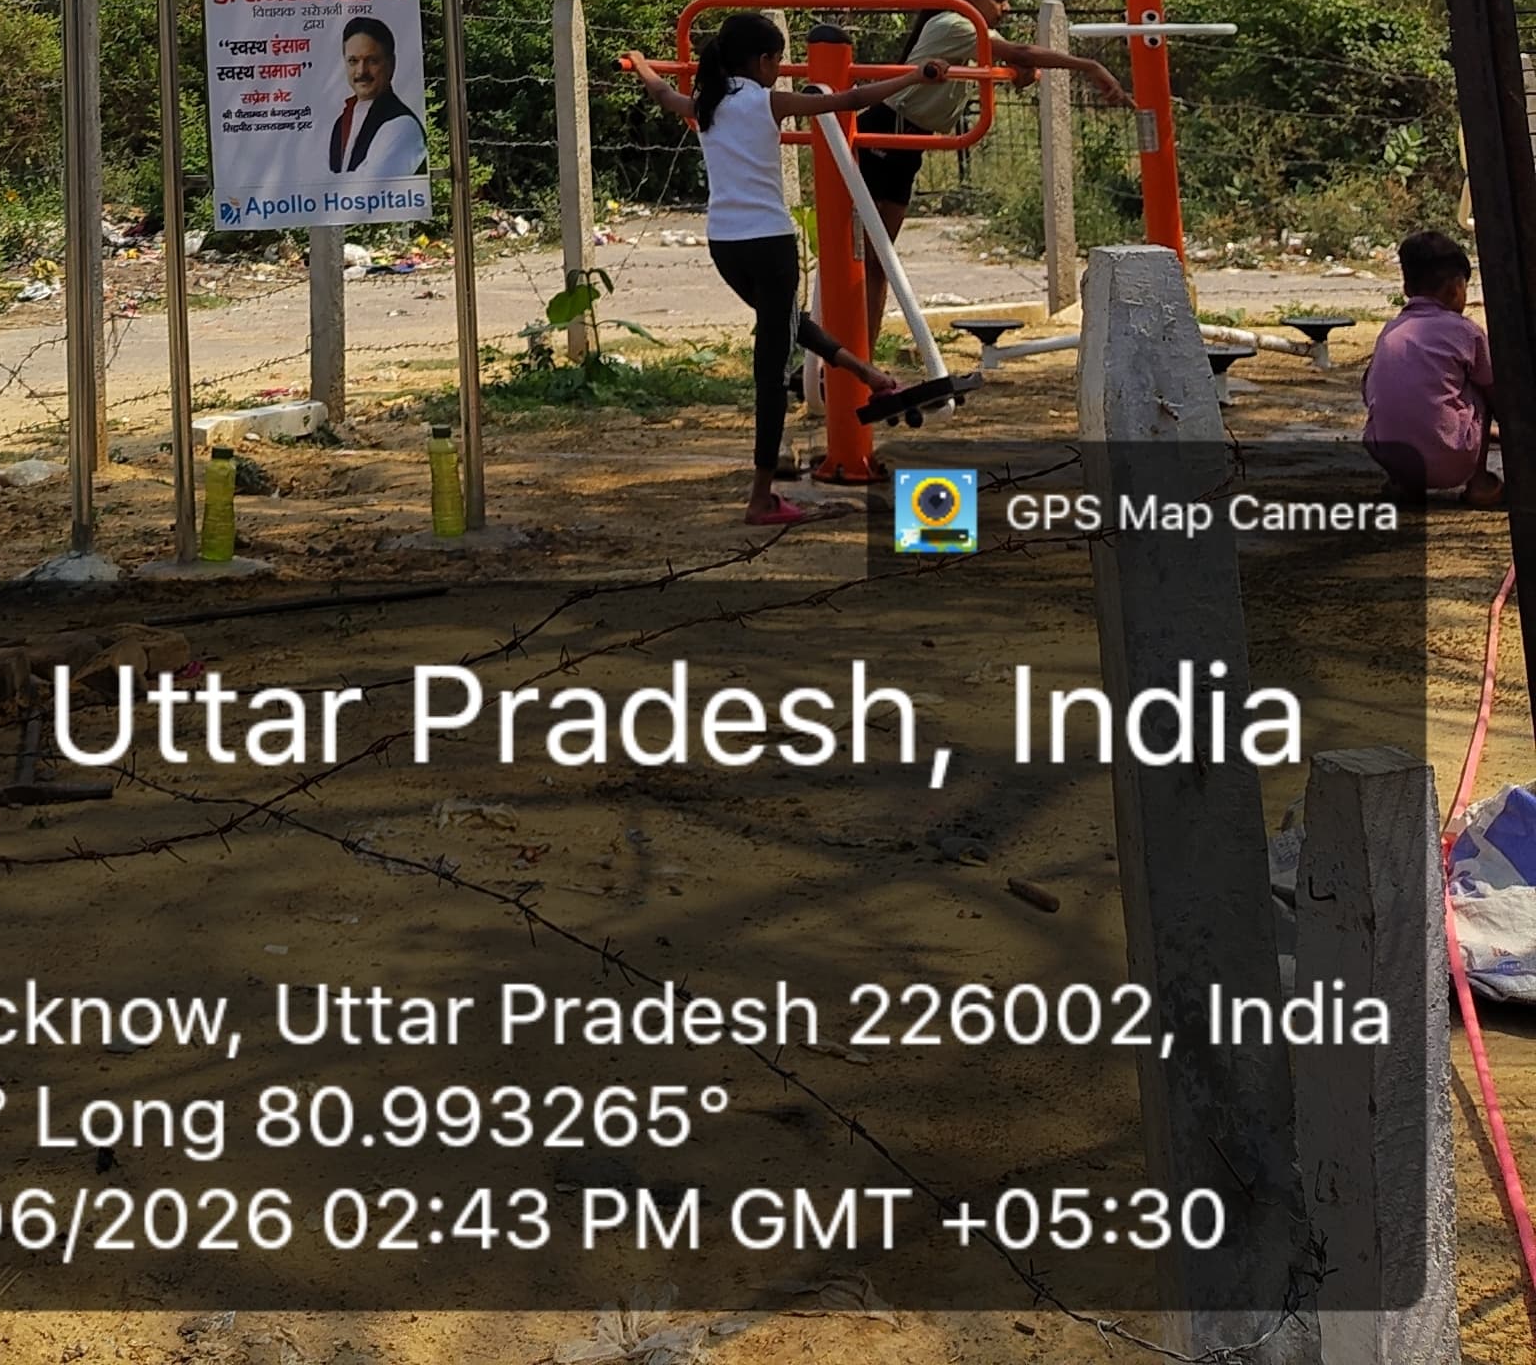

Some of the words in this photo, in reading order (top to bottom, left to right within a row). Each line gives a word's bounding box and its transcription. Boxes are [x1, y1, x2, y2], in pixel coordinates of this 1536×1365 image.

[252, 4, 296, 18] विधायक
[301, 3, 342, 16] सरोजनी
[347, 4, 373, 15] नगर
[303, 19, 324, 32] द्वारा
[270, 33, 310, 56] इंसान
[216, 65, 255, 81] स्वस्थ
[240, 89, 270, 105] सप्रेम
[222, 108, 233, 120] श्री
[245, 193, 316, 219] Apollo
[324, 188, 426, 215] Hospitals
